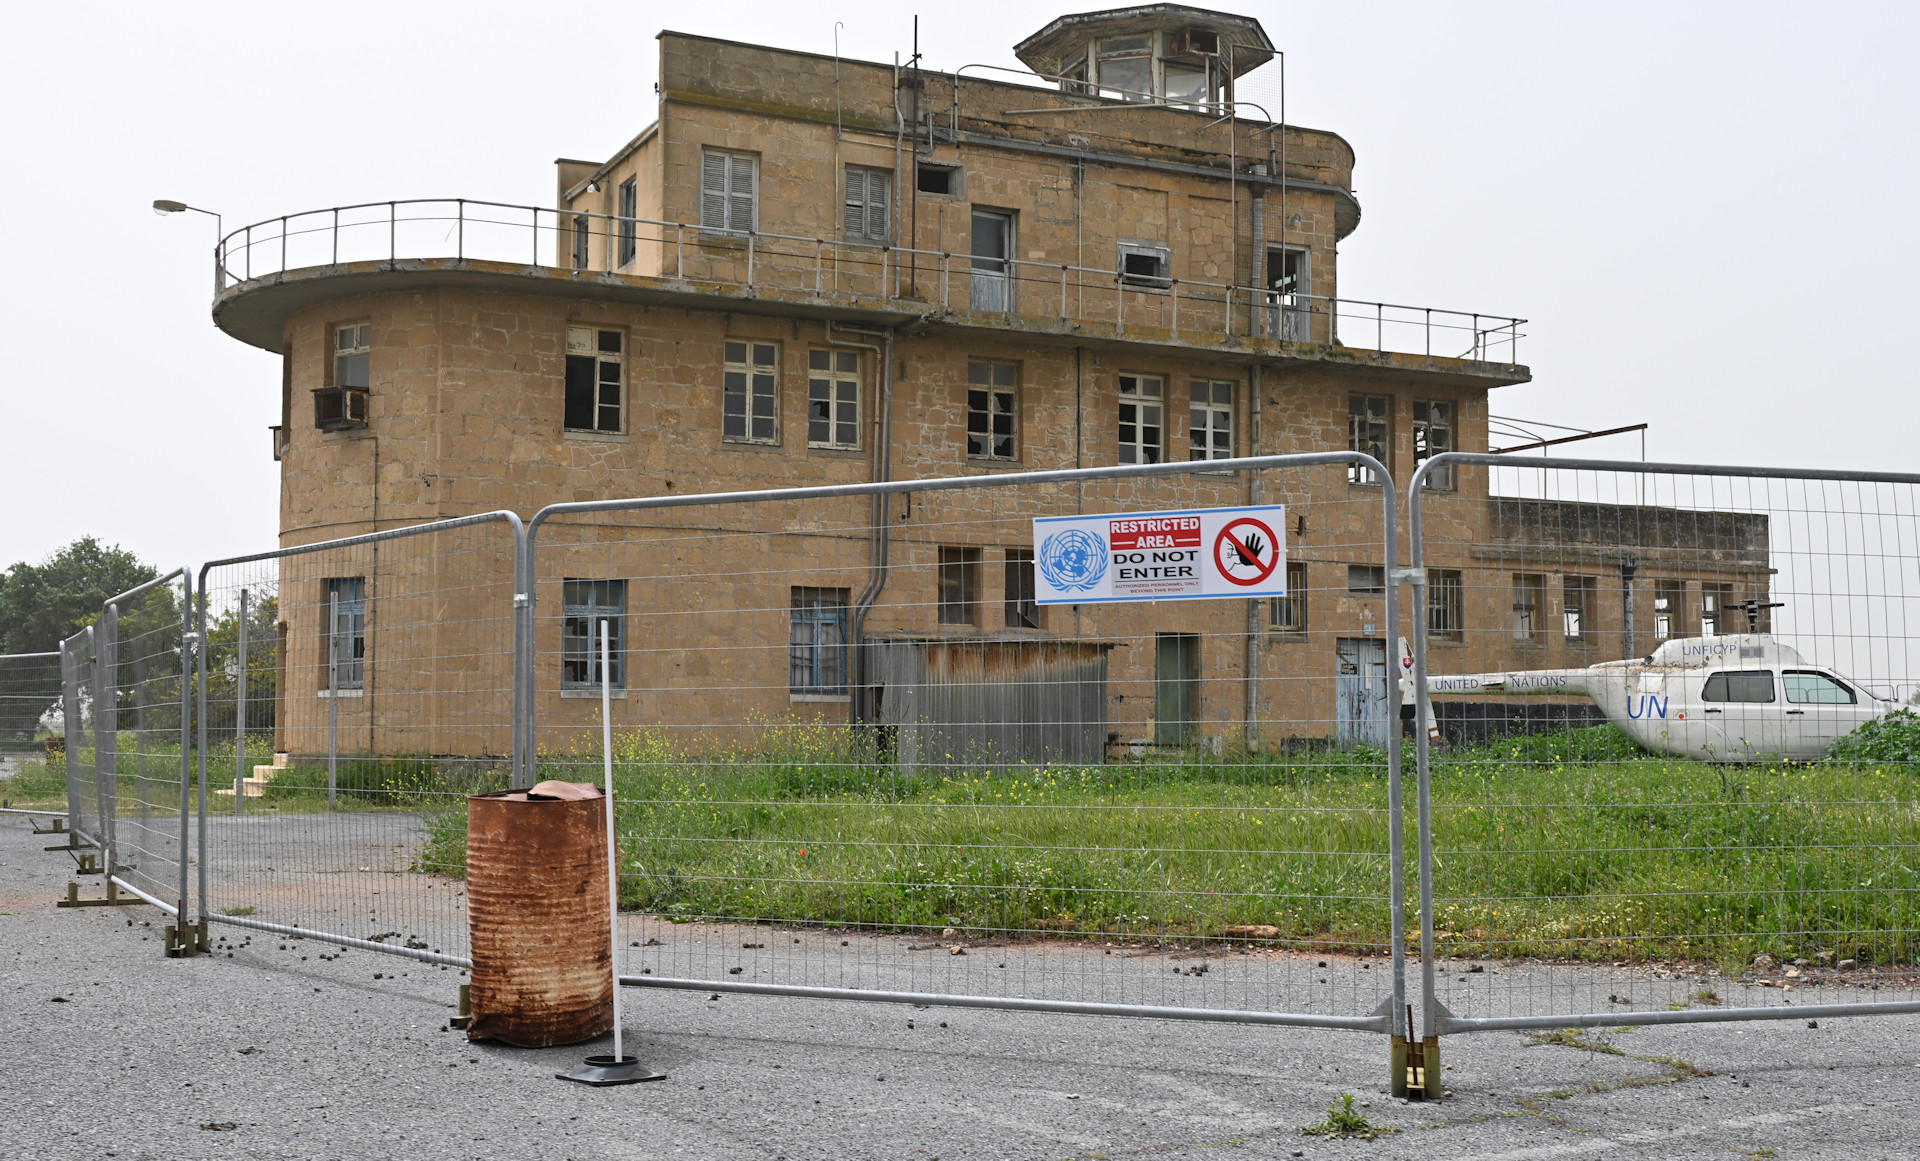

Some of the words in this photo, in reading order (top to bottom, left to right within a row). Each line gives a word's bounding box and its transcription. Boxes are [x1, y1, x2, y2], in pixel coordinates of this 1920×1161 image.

[1111, 518, 1199, 533] RESTRICTED
[1136, 535, 1175, 548] AREA
[1114, 553, 1145, 564] DO
[1153, 551, 1198, 562] NOT
[1120, 566, 1193, 578] ENTER
[1683, 644, 1737, 655] UNFICYP
[1435, 679, 1478, 690] UNITED
[1512, 676, 1566, 687] NATIONS
[1628, 695, 1669, 719] UN
